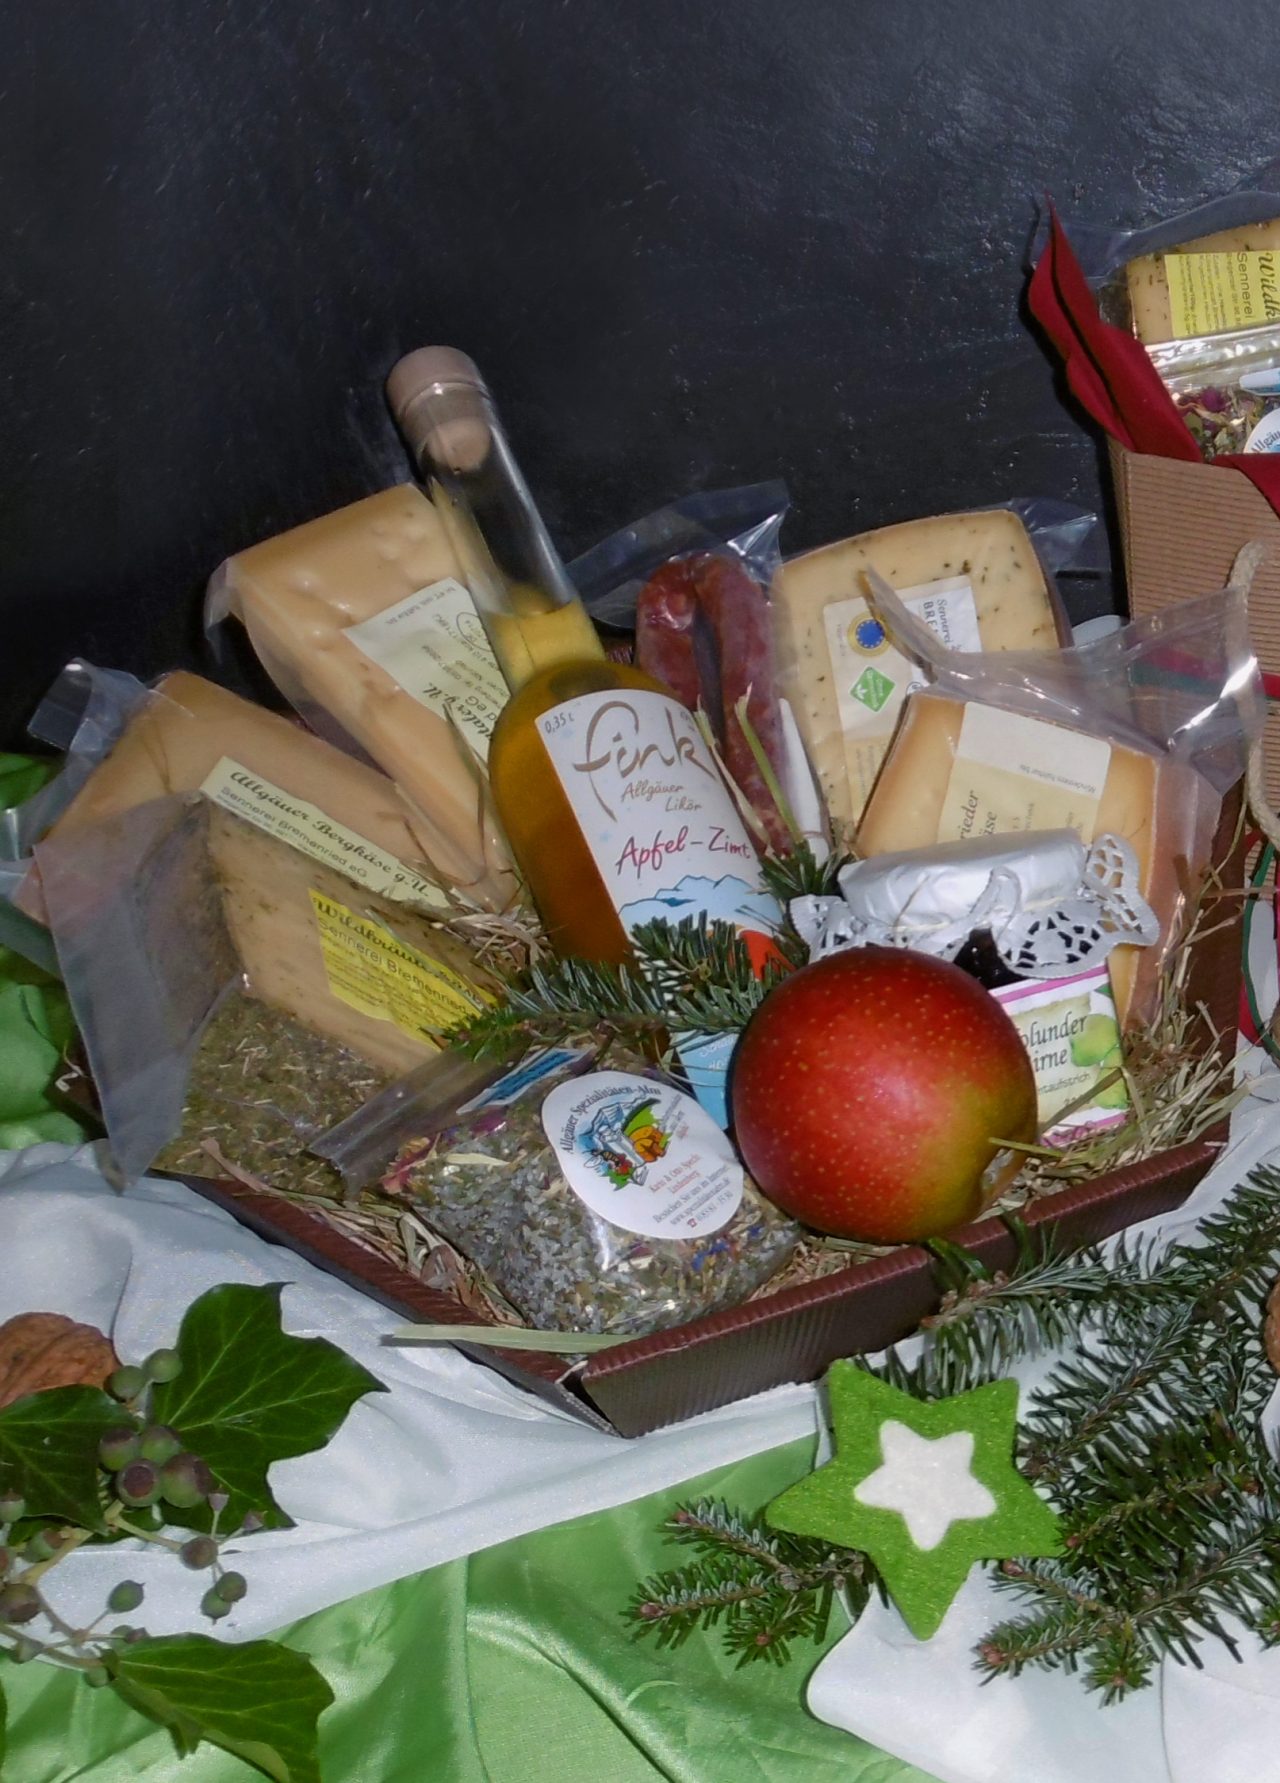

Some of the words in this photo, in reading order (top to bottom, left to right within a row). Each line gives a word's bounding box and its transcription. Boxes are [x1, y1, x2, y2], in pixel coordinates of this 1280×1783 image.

[545, 712, 567, 734] 0,35
[620, 780, 684, 803] Allgäuer
[665, 797, 703, 813] Likör
[220, 786, 277, 821] Sennerei
[277, 820, 348, 865] Bremenried
[348, 862, 369, 878] eG
[229, 770, 310, 821] Allgäuer
[312, 819, 392, 873] Bergkäse
[317, 919, 385, 964] Sennerei
[386, 960, 469, 1013] Bremenried
[1017, 1011, 1087, 1048] olunder
[1033, 1049, 1068, 1072] irne
